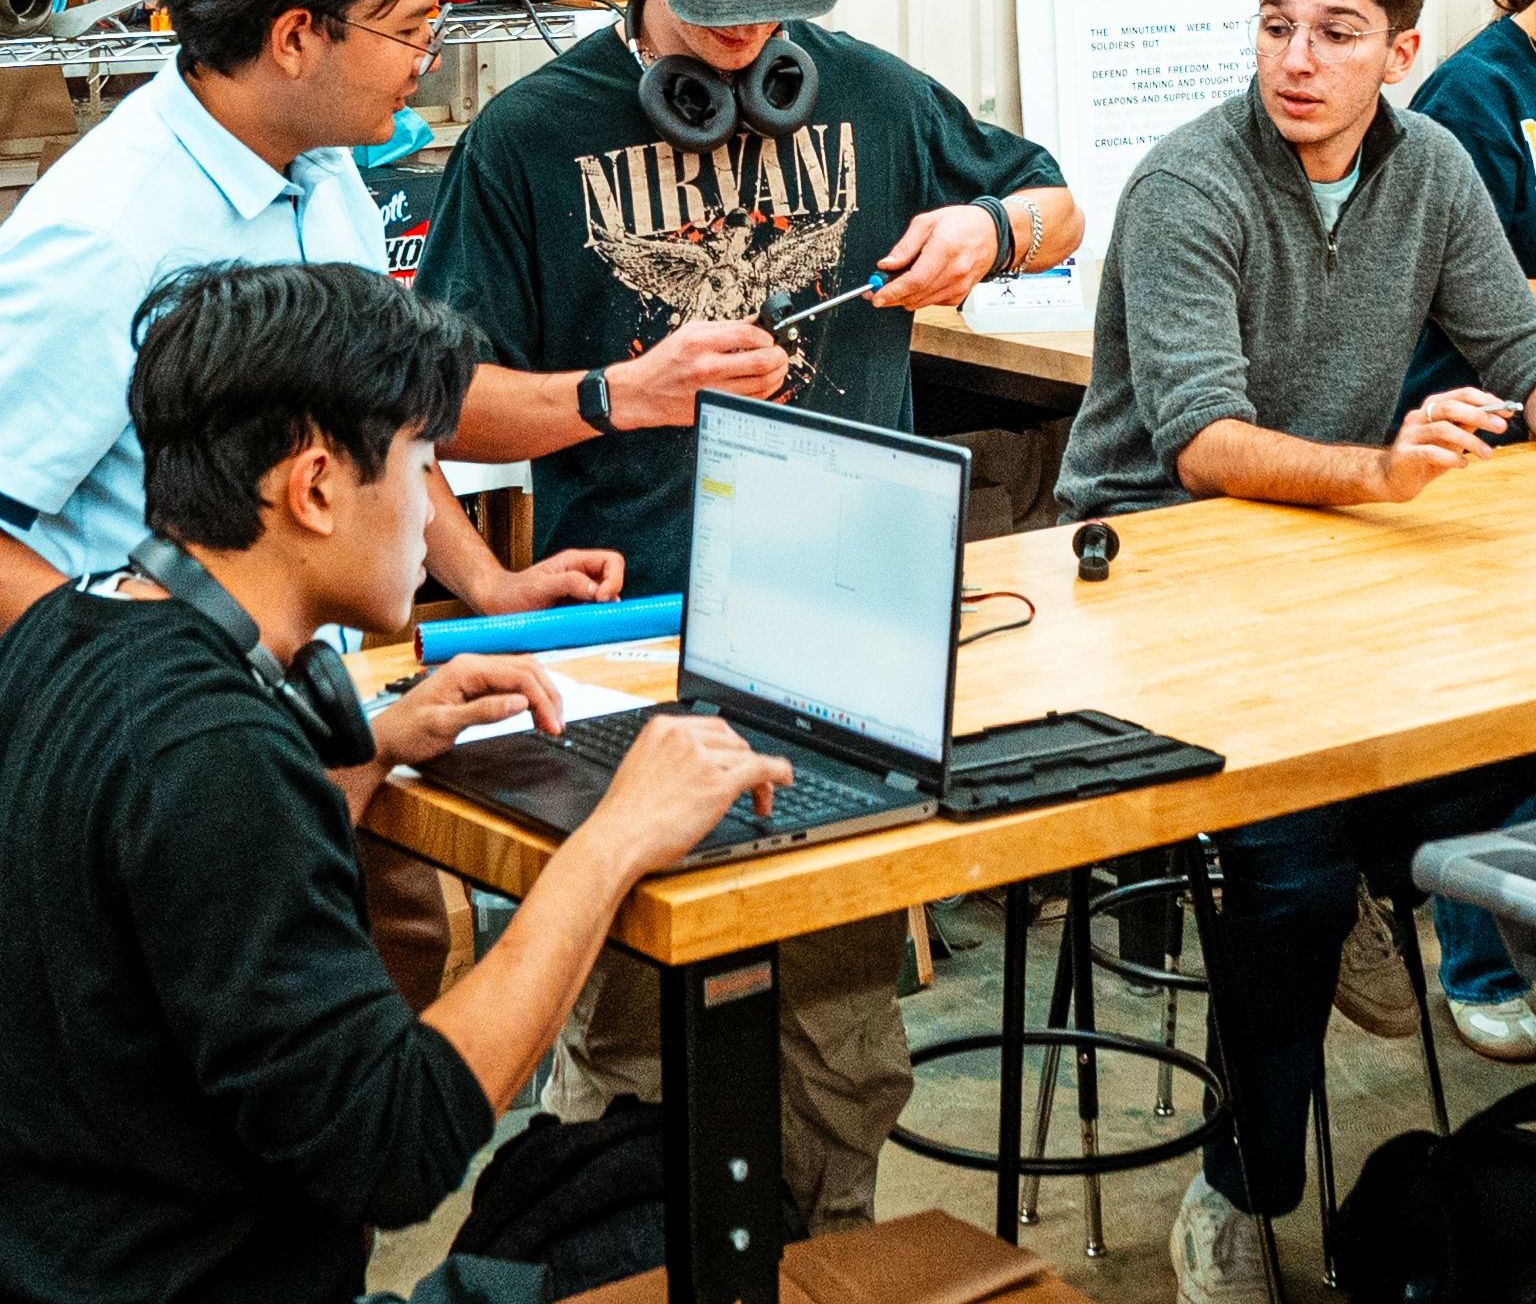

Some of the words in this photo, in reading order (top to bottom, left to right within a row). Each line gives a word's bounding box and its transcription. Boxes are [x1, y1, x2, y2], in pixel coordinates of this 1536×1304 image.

[1090, 27, 1109, 38] THE
[1120, 24, 1176, 37] MINUTEMEN
[1186, 22, 1212, 33] WERE
[1222, 20, 1240, 31] NOT
[1090, 40, 1136, 52] SOLDIERS
[1142, 39, 1161, 49] BUT
[1092, 68, 1129, 80] DEFEND
[1135, 66, 1162, 77] THEIR
[1218, 62, 1240, 72] THEY
[1131, 79, 1174, 91] TRAINING
[1177, 78, 1196, 89] AND
[1199, 75, 1234, 87] FOUGHT
[1093, 95, 1139, 108] WEAPONS
[1141, 94, 1161, 105] AND
[1163, 90, 1206, 103] SUPPLIES
[1094, 135, 1134, 149] CRUCIAL
[1135, 134, 1146, 145] IN
[575, 120, 860, 247] NIRVANA
